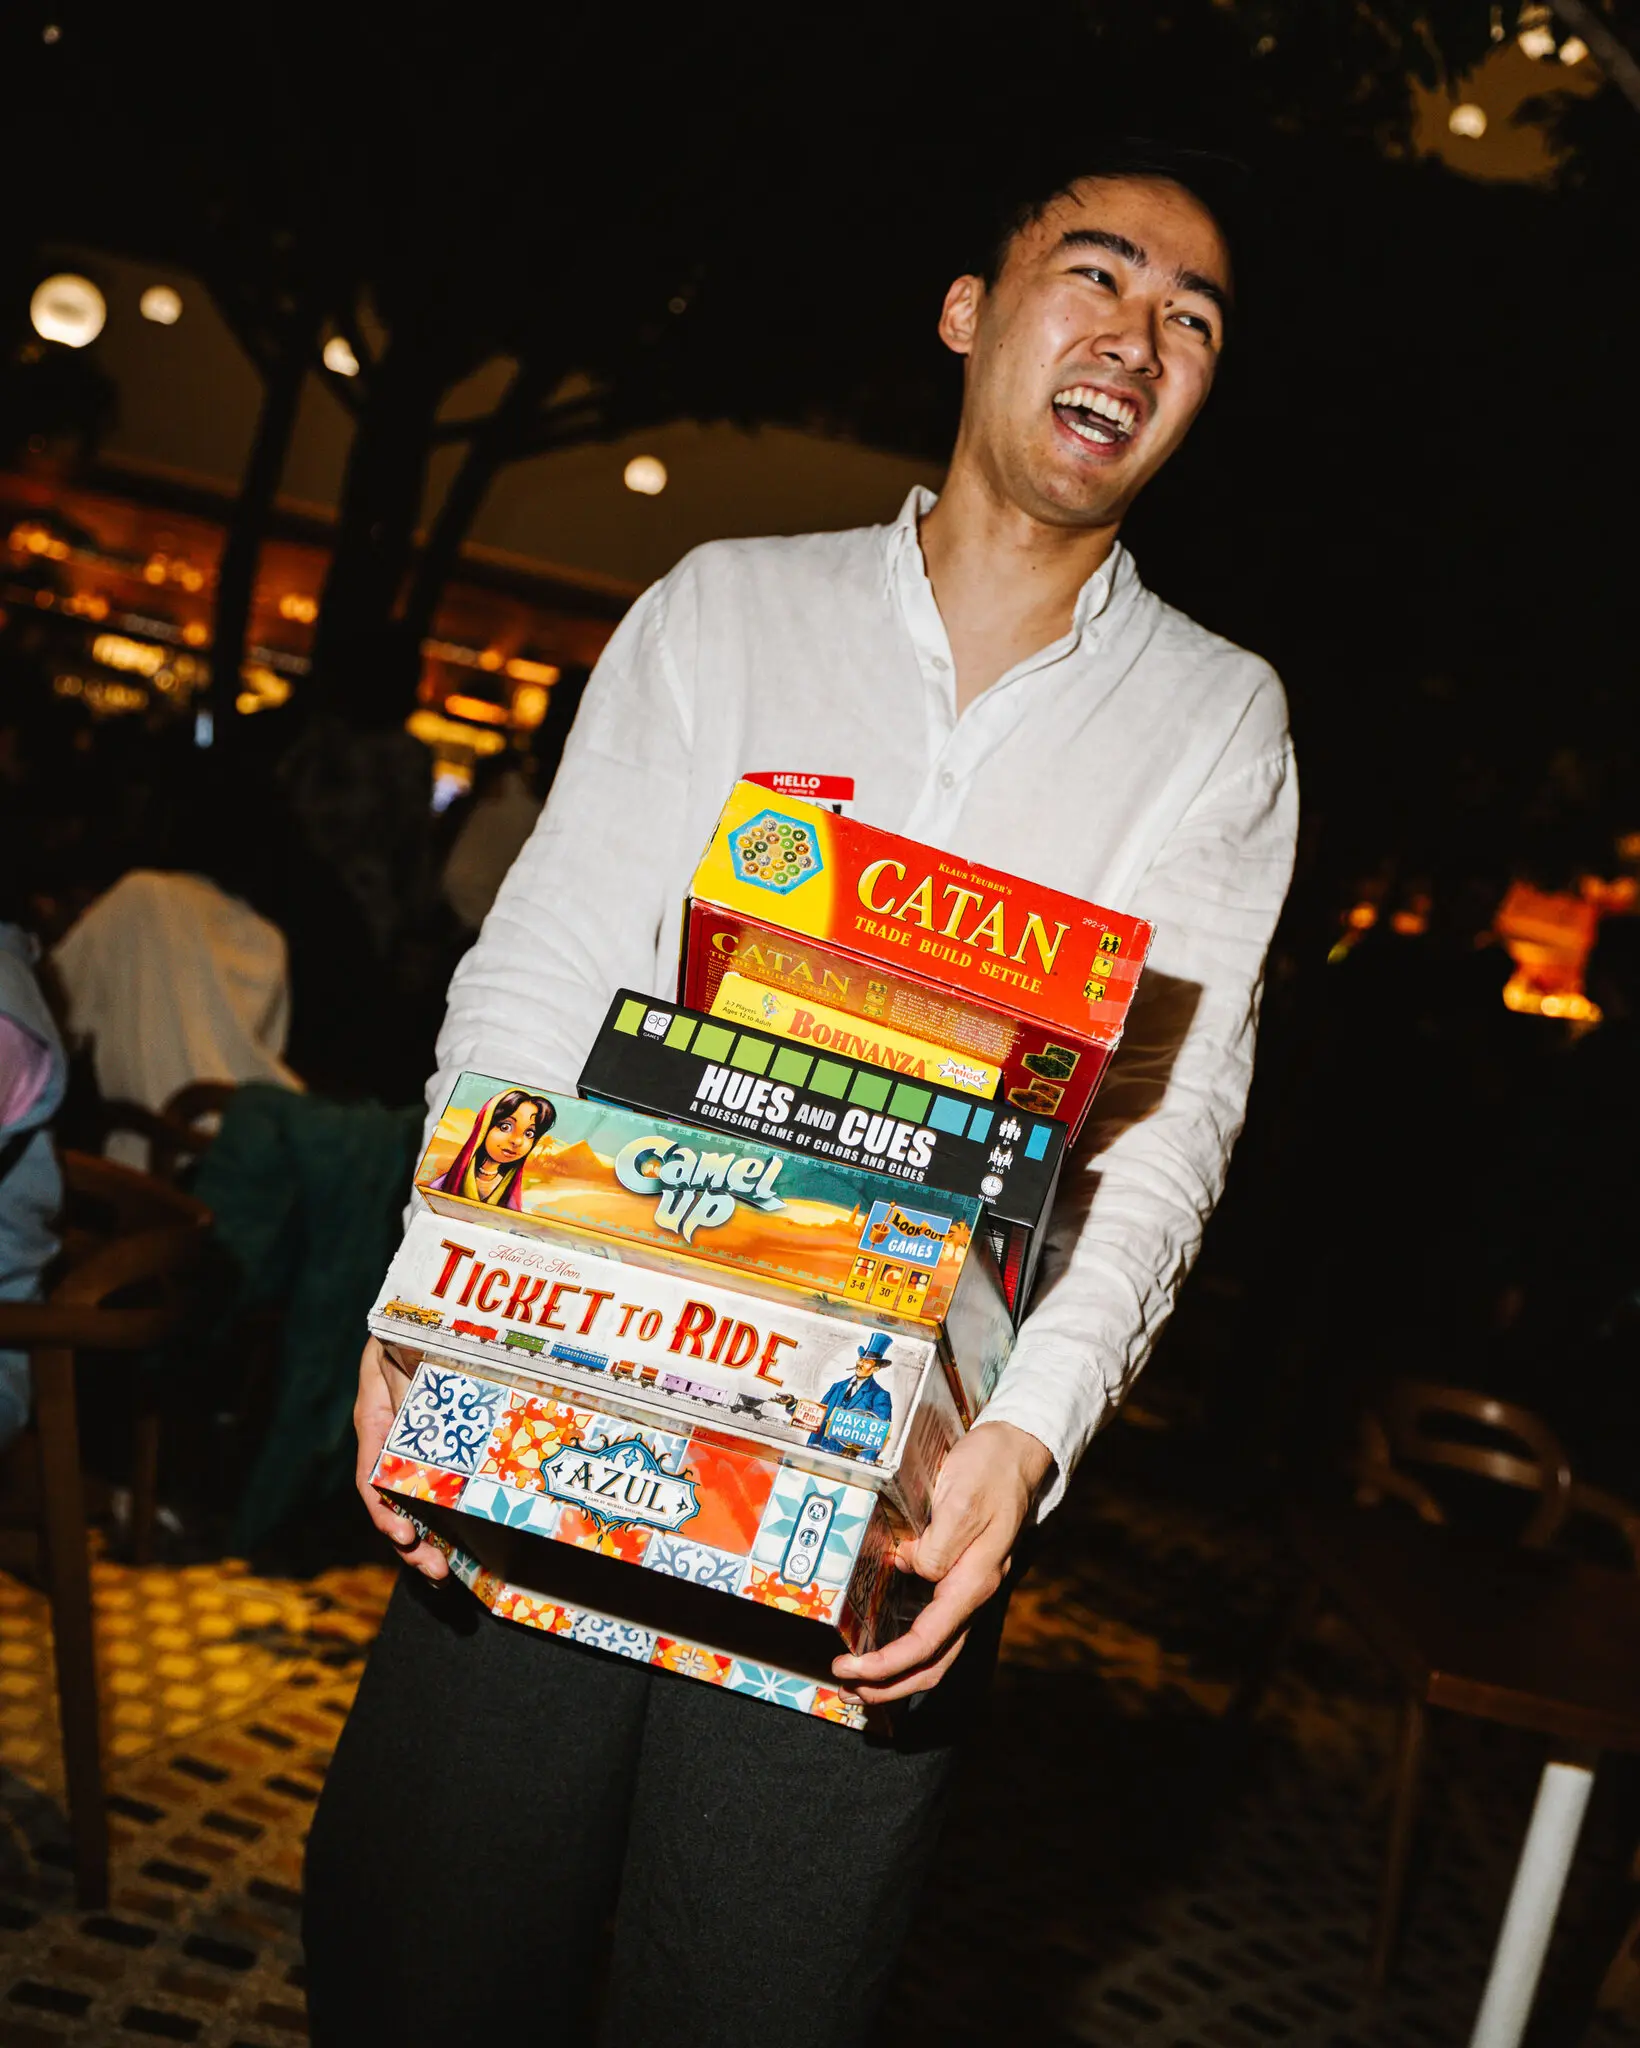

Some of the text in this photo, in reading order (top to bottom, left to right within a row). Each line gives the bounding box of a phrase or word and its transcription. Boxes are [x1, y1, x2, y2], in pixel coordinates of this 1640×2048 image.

[773, 774, 821, 789] HELLO
[938, 863, 968, 880] KLAUS
[857, 859, 1071, 975] CATAN
[709, 950, 750, 969] TRADE
[711, 932, 852, 995] CATAN
[854, 915, 1042, 994] TRADE BUILD SETTLE
[722, 1006, 738, 1016] Ages
[755, 1018, 772, 1028] Adult
[735, 1003, 757, 1015] Players
[787, 1007, 927, 1080] BOHNANZA
[947, 1066, 981, 1084] AMIGO
[695, 1063, 937, 1169] HUES AND CUES
[689, 1101, 926, 1183] A GUESSING GAME OF COLORS AND CLUES
[892, 1212, 946, 1242] LOOK OUT
[488, 1244, 526, 1263] Alan
[545, 1258, 581, 1279] Moon
[888, 1239, 933, 1258] GAMES
[850, 1279, 865, 1291] 3-8
[907, 1295, 917, 1303] 8+
[431, 1238, 615, 1335] TICKET
[616, 1303, 663, 1341] TO
[667, 1299, 798, 1387] RIDE
[835, 1413, 886, 1433] DAYS OF
[565, 1461, 666, 1513] AZUL
